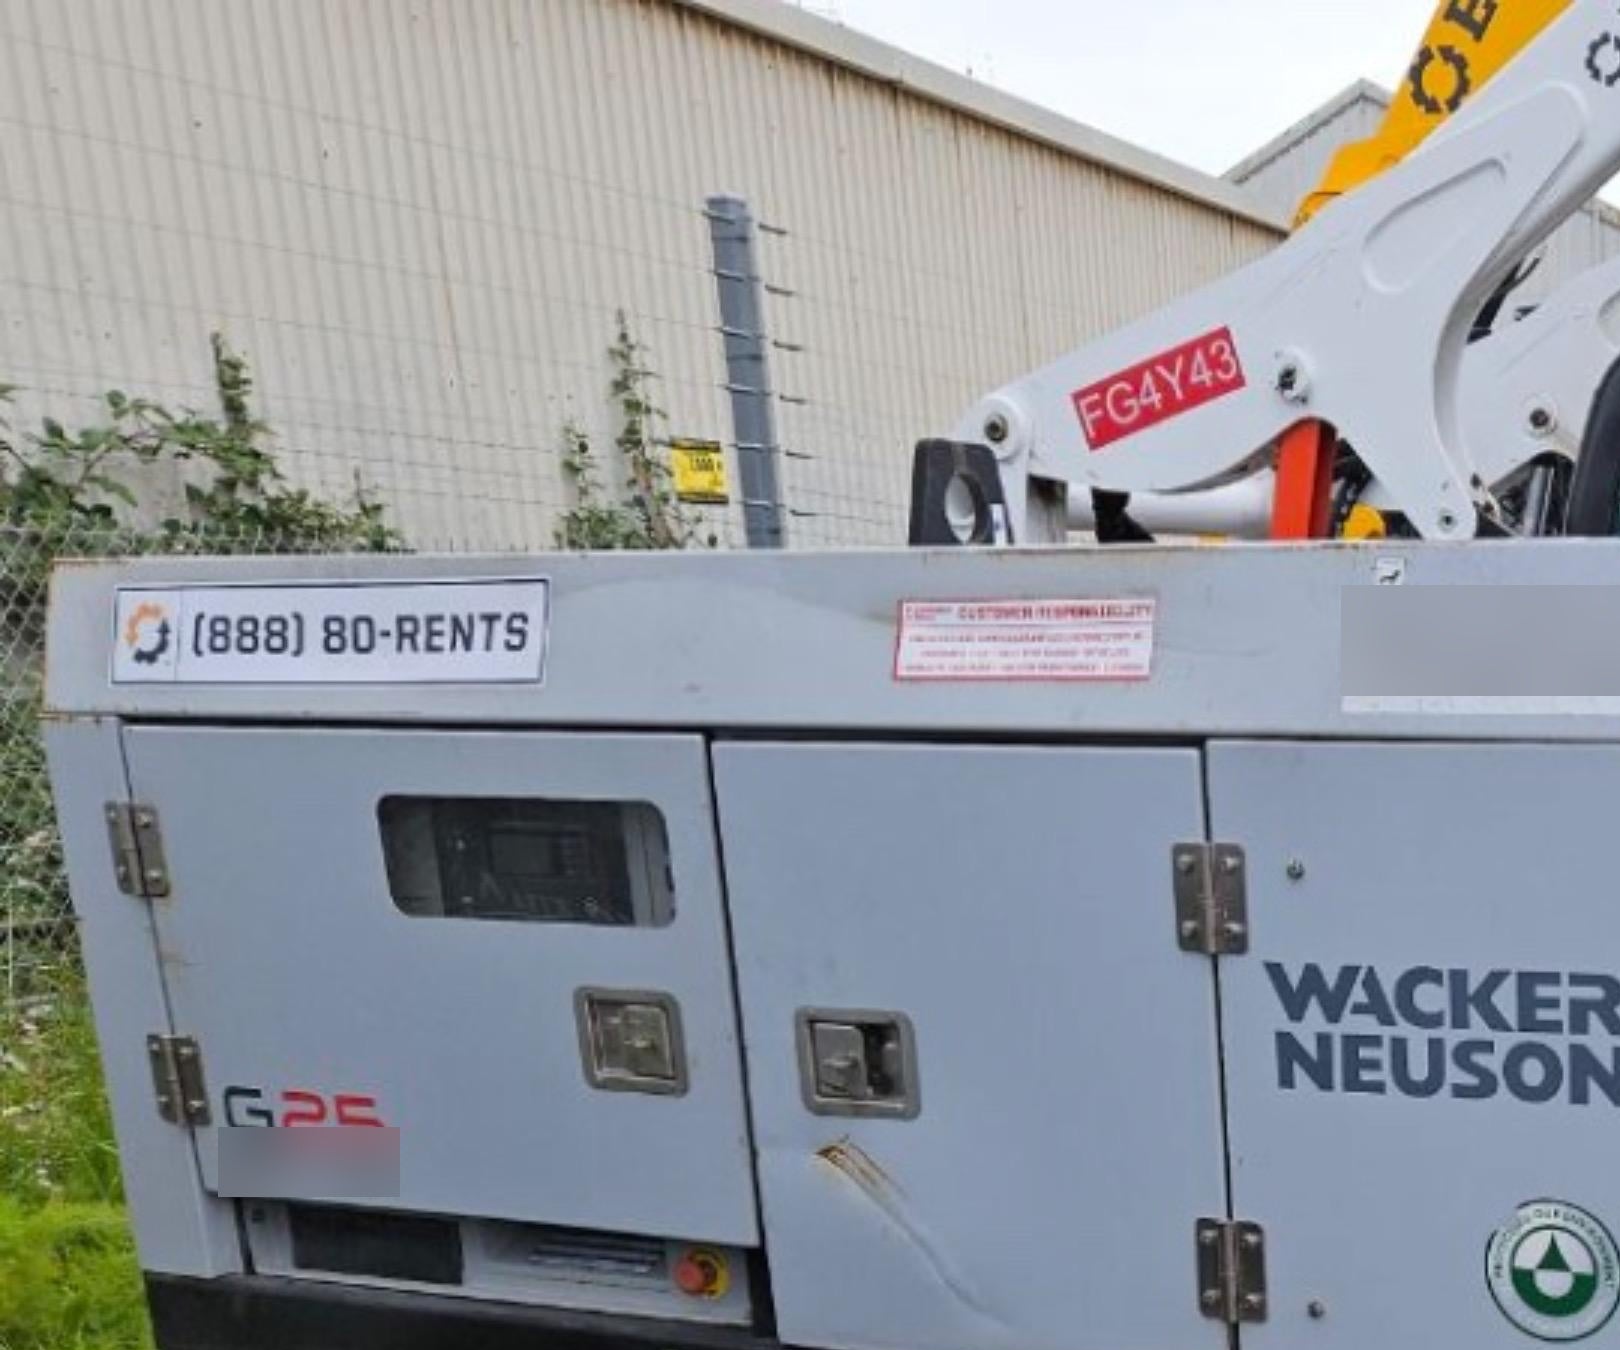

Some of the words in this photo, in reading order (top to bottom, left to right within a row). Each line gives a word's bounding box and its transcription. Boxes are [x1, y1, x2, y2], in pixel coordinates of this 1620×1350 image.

[1081, 337, 1240, 440] FG4Y43
[191, 612, 305, 657] (888)
[322, 611, 530, 656] 80-RENTS
